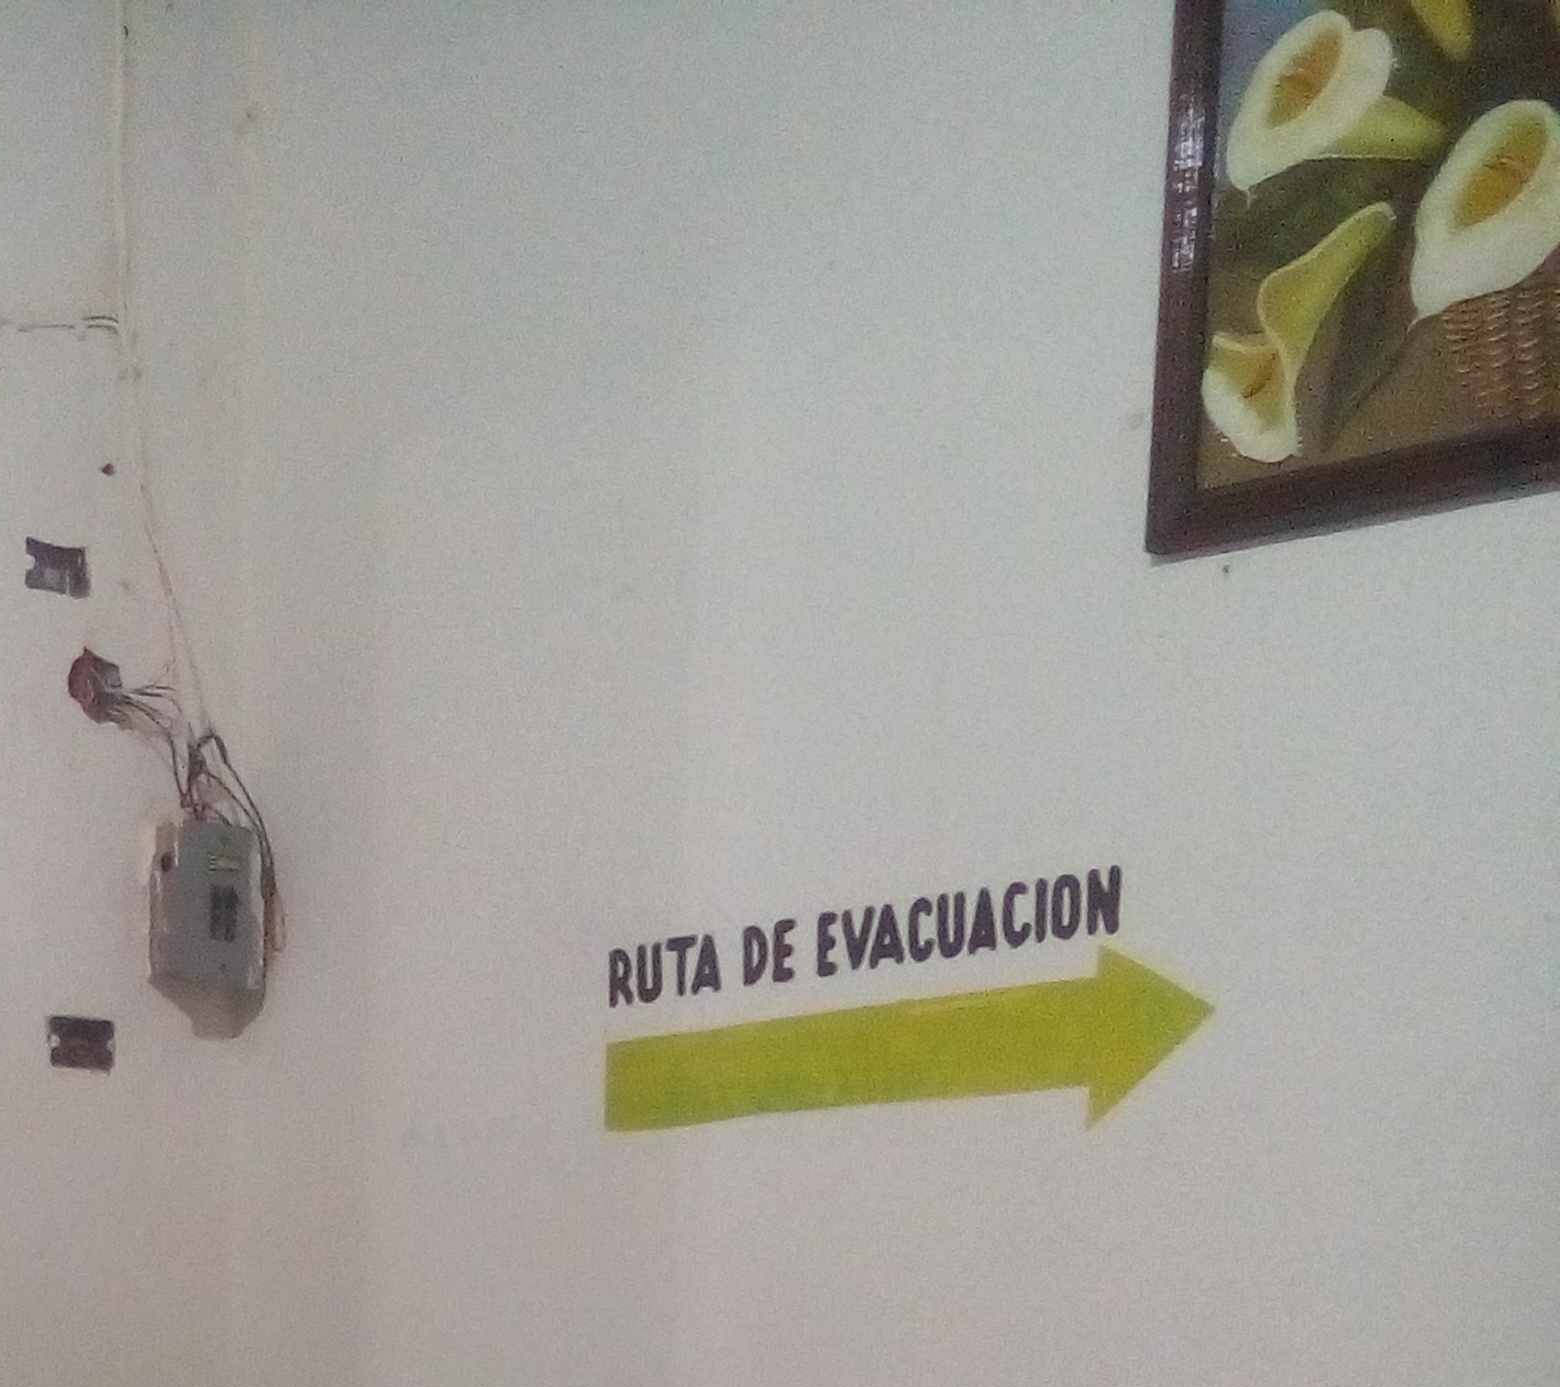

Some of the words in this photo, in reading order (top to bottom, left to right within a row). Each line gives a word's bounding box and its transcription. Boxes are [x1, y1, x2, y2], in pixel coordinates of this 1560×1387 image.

[607, 934, 722, 1008] RUTA
[742, 918, 797, 987] DE
[817, 865, 1123, 978] EVACUACION
